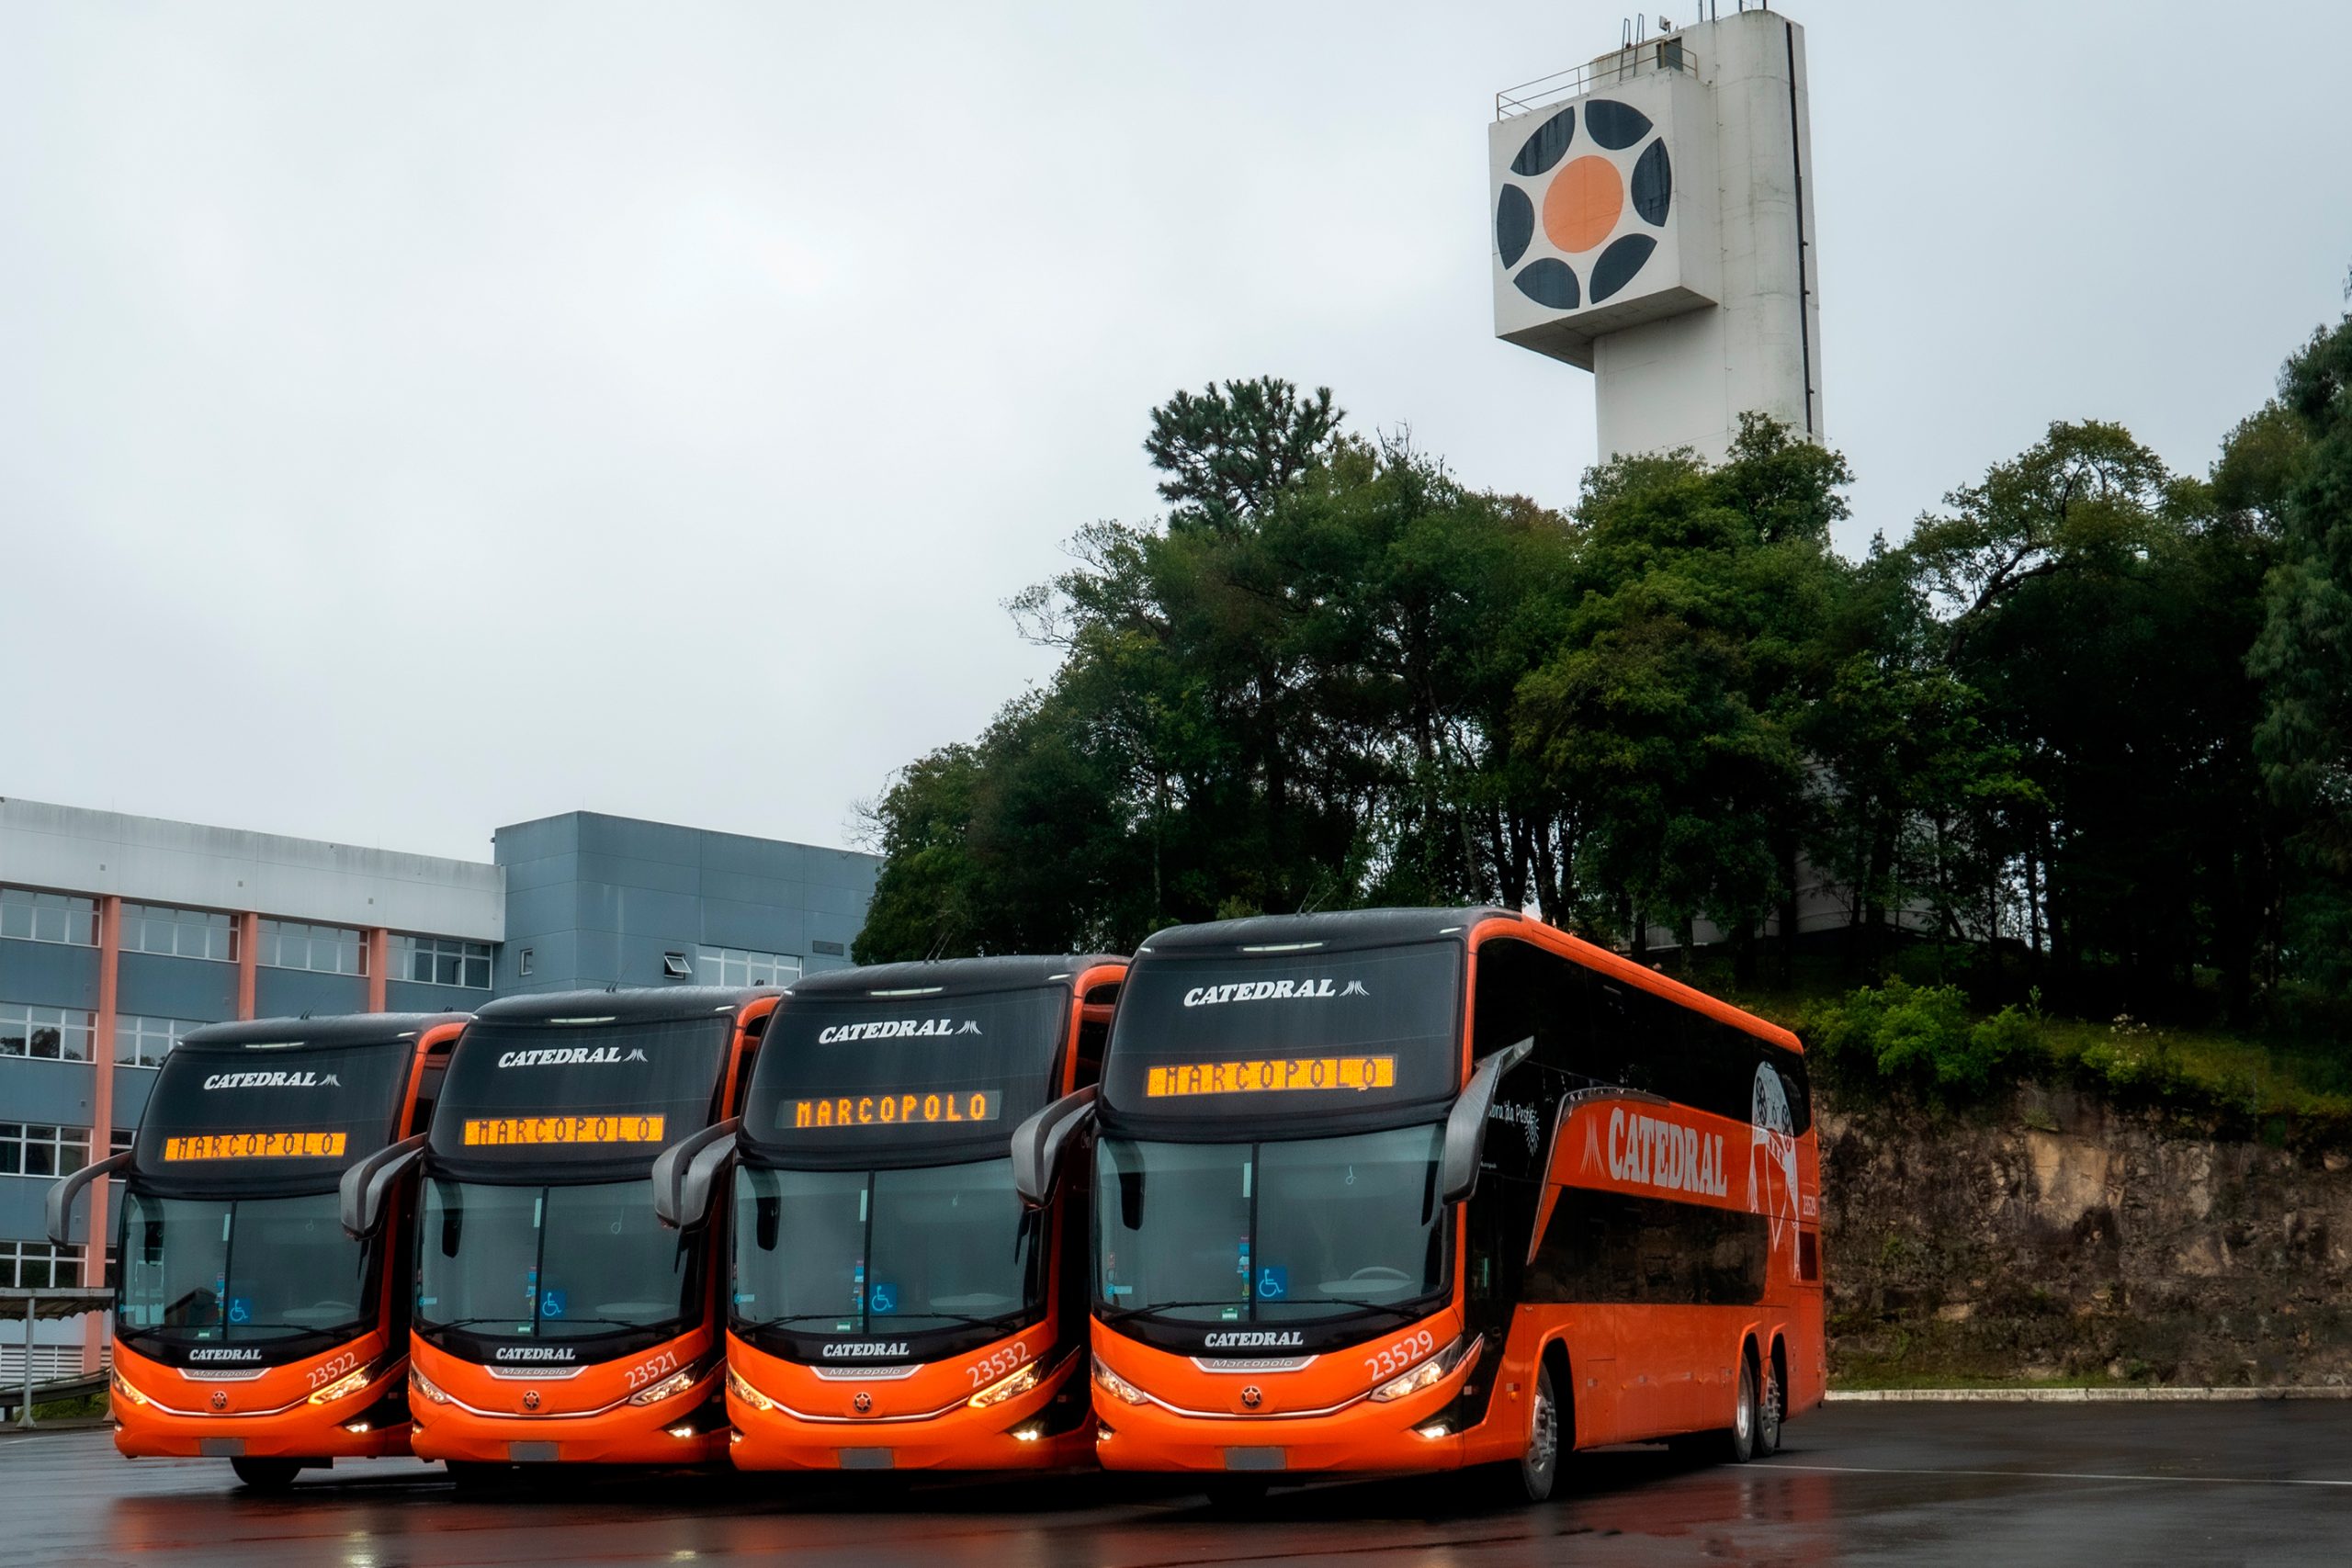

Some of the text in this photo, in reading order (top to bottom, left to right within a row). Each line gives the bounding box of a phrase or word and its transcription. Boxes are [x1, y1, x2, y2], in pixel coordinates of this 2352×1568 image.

[1183, 979, 1337, 1007] CATEDRAL
[819, 1019, 954, 1044] CATEDRAL
[498, 1047, 621, 1068] CATEDRAL
[203, 1071, 317, 1090] CATEDRAL
[1164, 1058, 1377, 1095] MARCOPOLO
[797, 1092, 986, 1128] MARCOPOLO
[478, 1117, 650, 1145] MARCOPOLO
[176, 1133, 334, 1160] MARCOPOLO
[1608, 1107, 1727, 1197] CATEDRAL
[822, 1342, 910, 1358] CATEDRAL
[1204, 1332, 1304, 1347] CATEDRAL
[189, 1348, 262, 1360] CATEDRAL
[496, 1348, 576, 1360] CATEDRAL
[966, 1341, 1032, 1388] 23532
[1212, 1358, 1294, 1368] Marcopolo
[1364, 1329, 1434, 1382] 23529
[192, 1369, 253, 1377] Marcopolo
[306, 1351, 359, 1389] 23522
[501, 1367, 568, 1376] Marcopolo
[625, 1350, 678, 1390] 23521
[829, 1367, 901, 1376] Marcopolo
